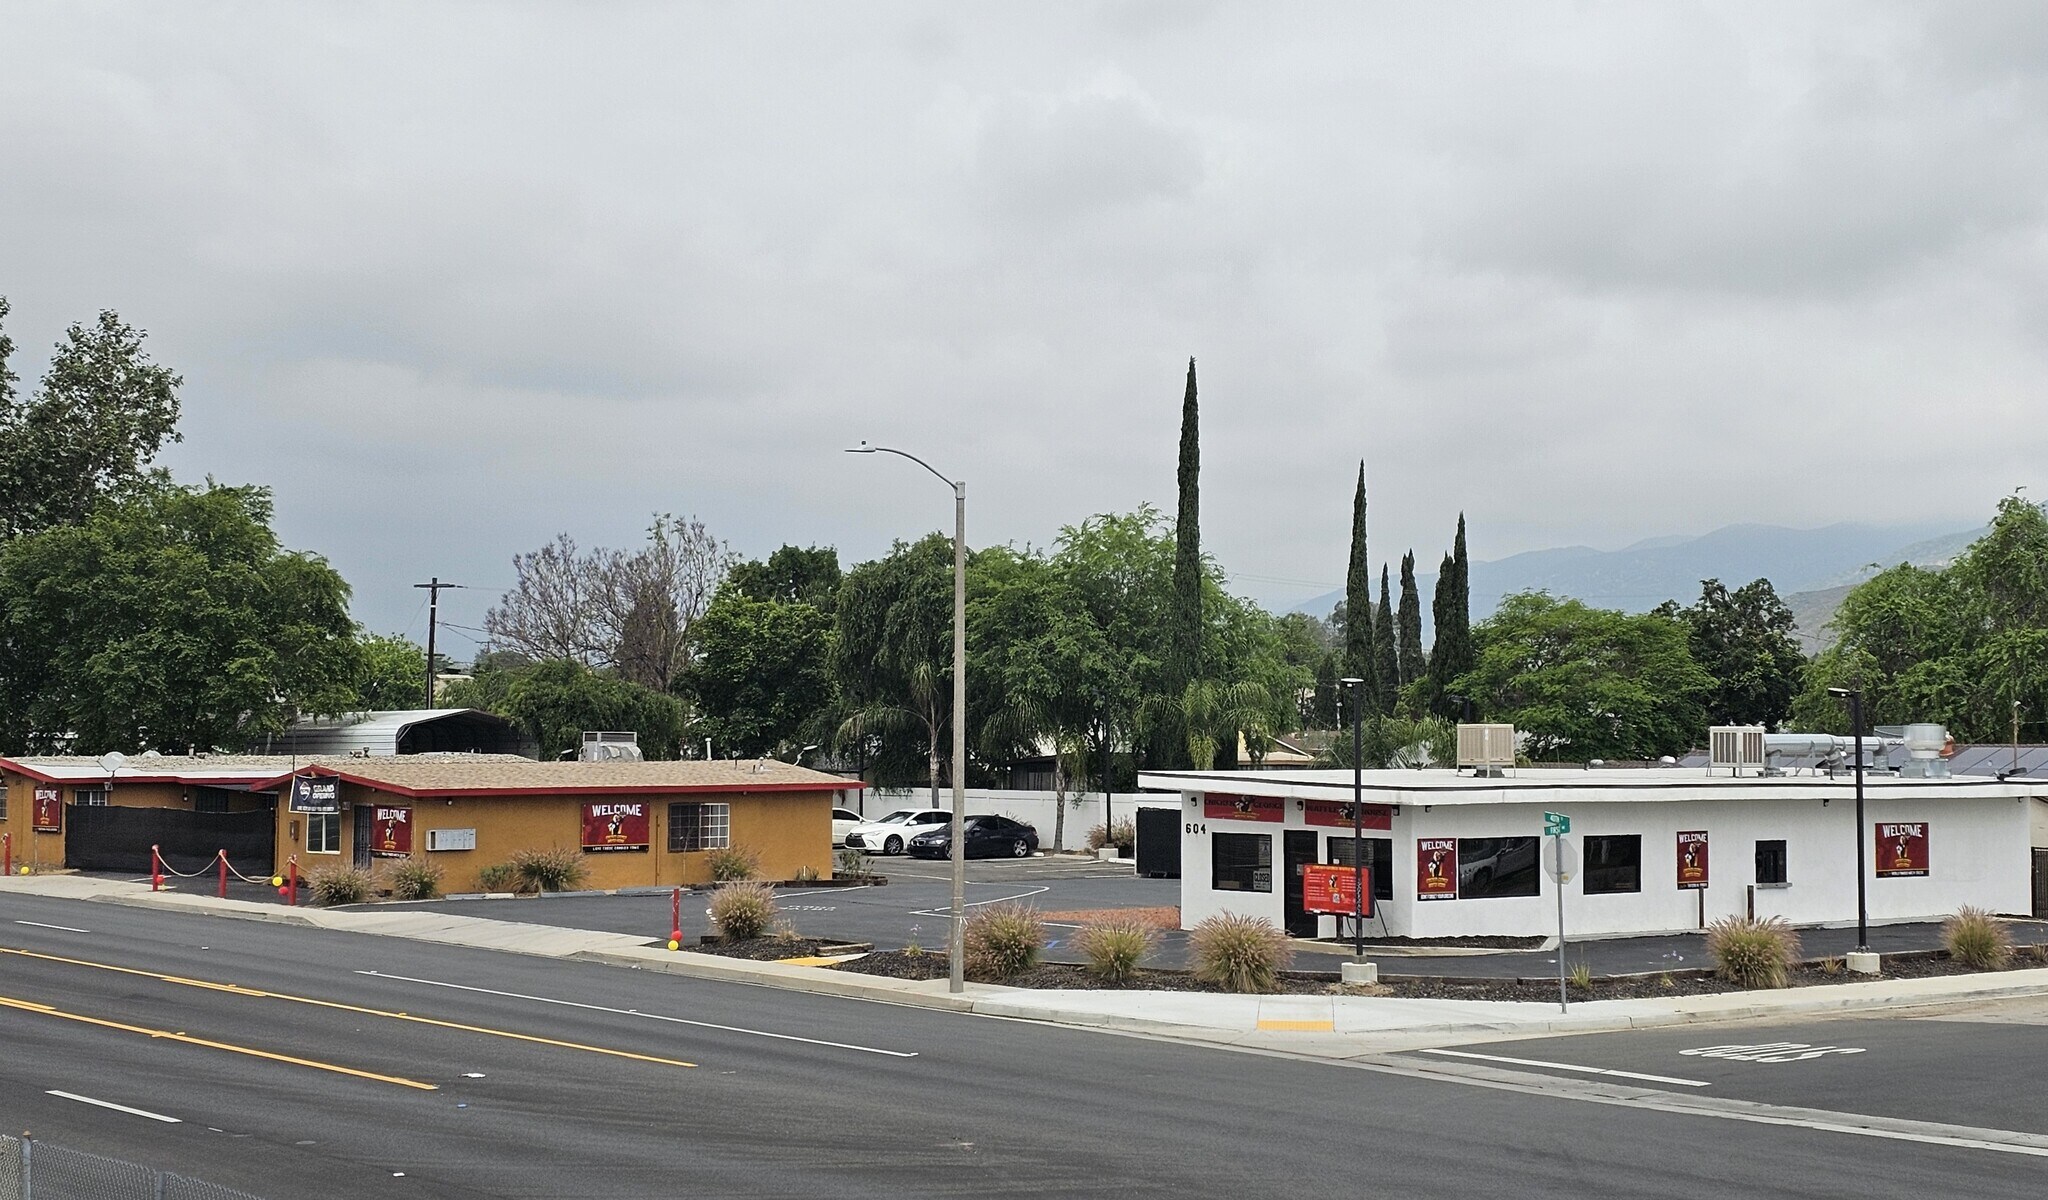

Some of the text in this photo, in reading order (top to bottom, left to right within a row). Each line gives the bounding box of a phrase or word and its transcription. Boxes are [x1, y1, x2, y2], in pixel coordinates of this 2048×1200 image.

[313, 784, 335, 792] GRAND
[35, 790, 57, 801] WELCOME
[377, 808, 407, 823] WELCOME
[592, 804, 642, 817] WELCOME
[1185, 823, 1206, 834] 604
[1882, 824, 1923, 838] WELCOME
[1679, 833, 1707, 843] WELCOME
[1421, 841, 1454, 851] WELCOME
